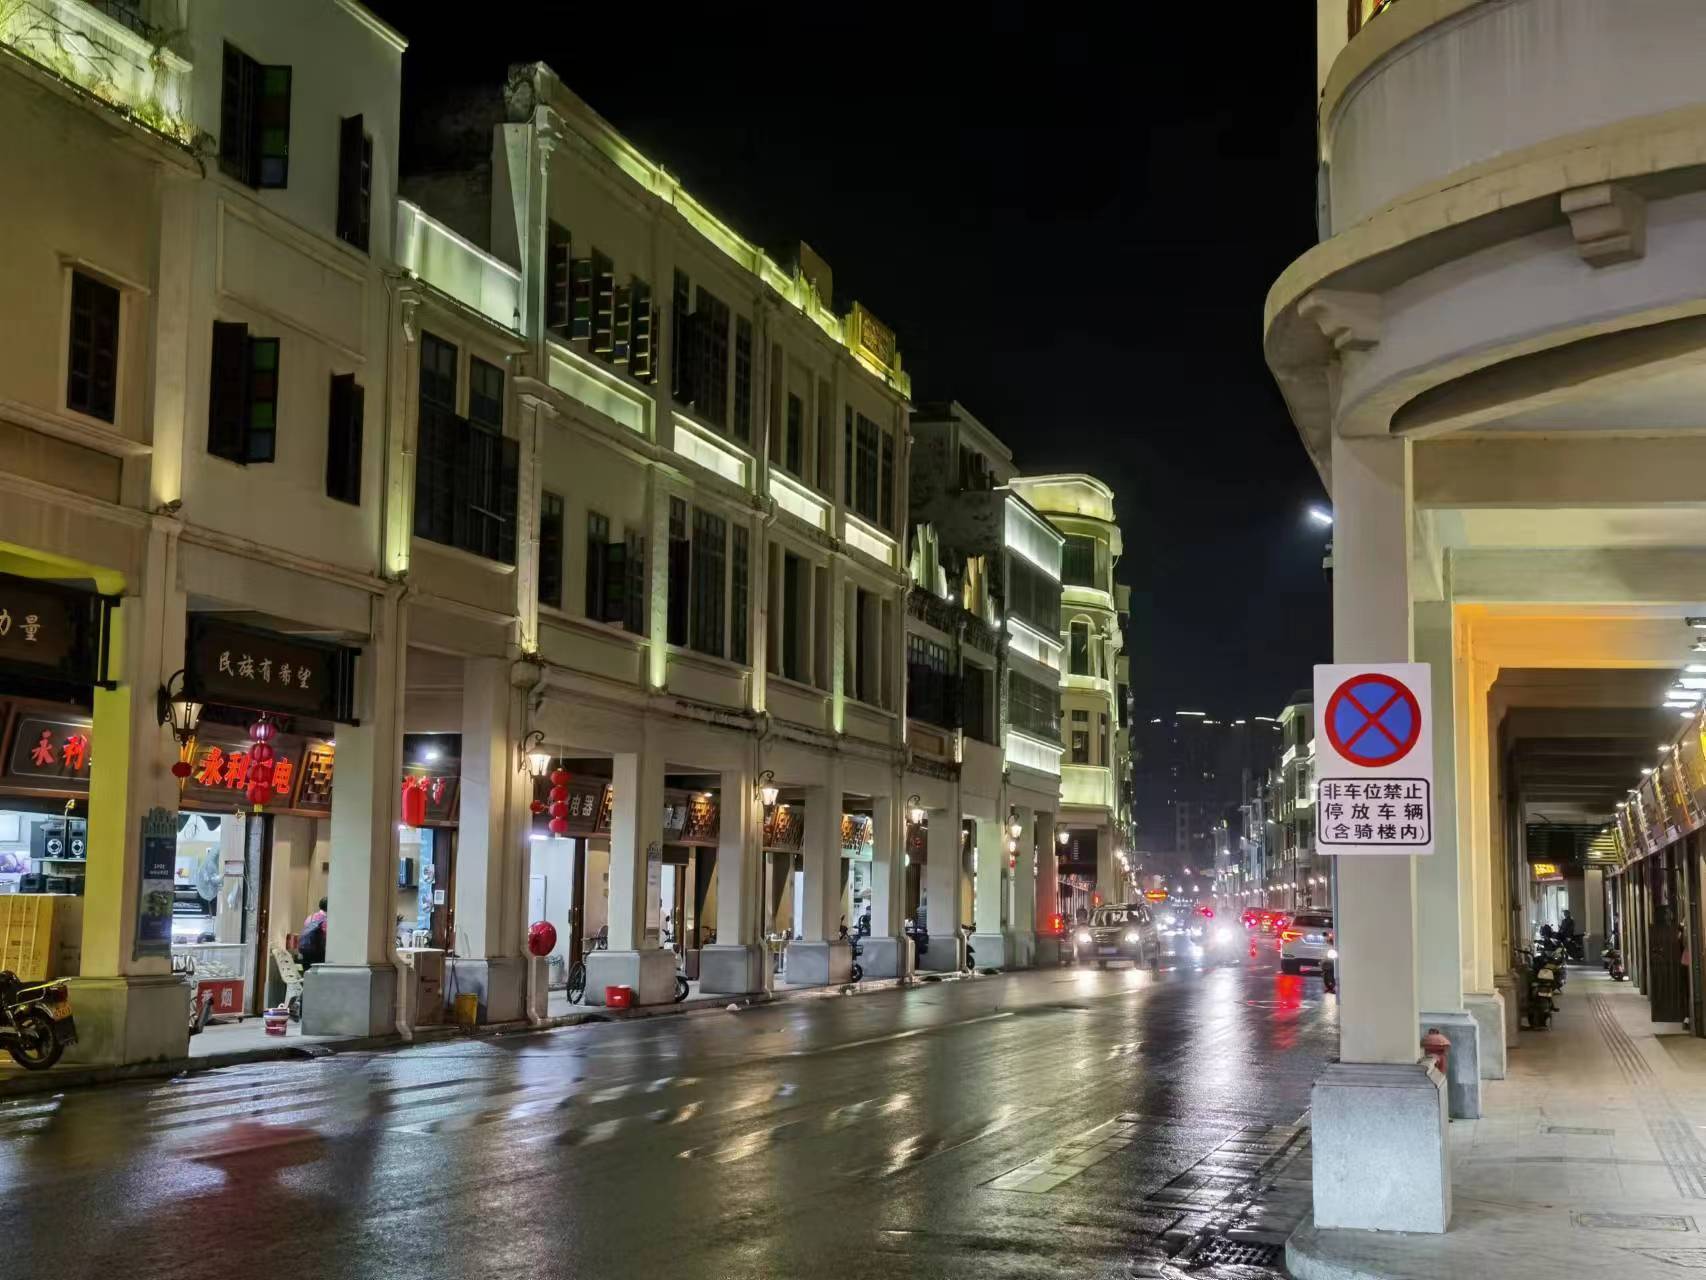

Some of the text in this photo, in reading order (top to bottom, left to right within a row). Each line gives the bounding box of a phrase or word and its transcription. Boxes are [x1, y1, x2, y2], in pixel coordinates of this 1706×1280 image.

[218, 650, 312, 689] 民族有希望
[198, 745, 293, 794] 永利电
[1323, 783, 1423, 800] 非车位禁止
[1324, 802, 1424, 820] 停放车辆
